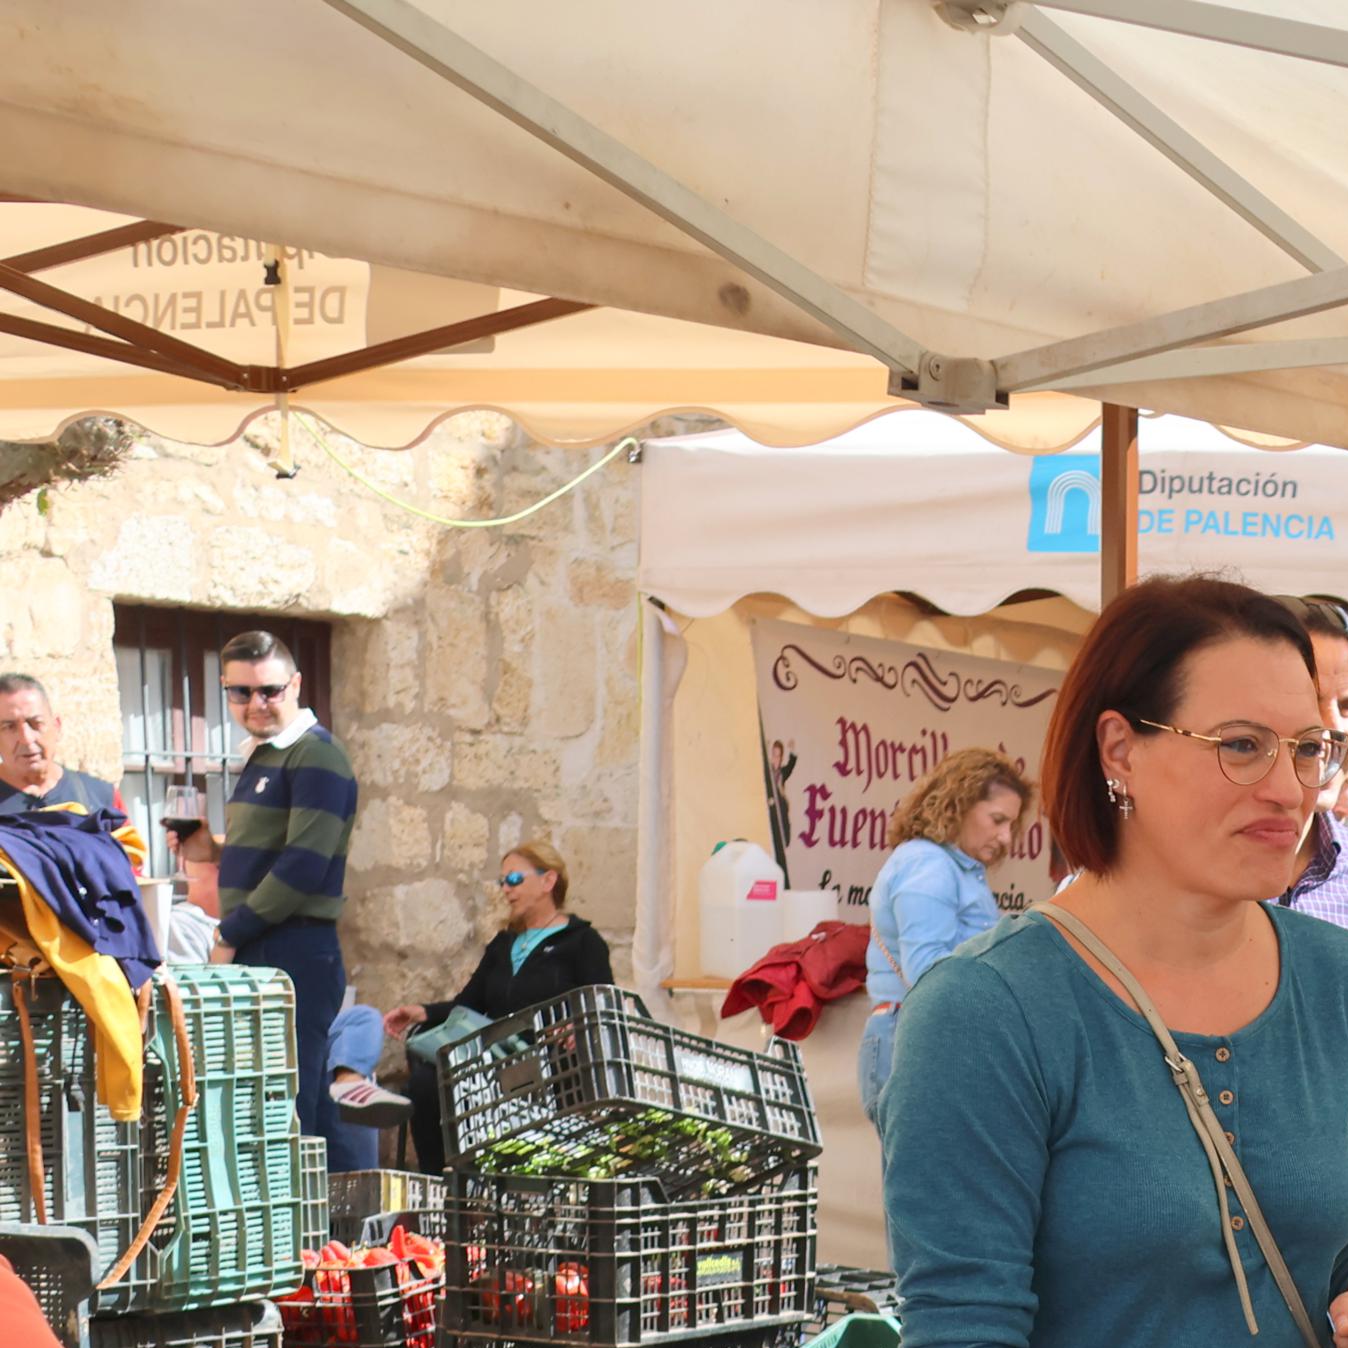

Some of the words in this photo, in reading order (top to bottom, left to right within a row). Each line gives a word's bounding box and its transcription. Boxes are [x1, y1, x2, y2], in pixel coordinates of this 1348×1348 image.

[1138, 469, 1298, 499] Diputación
[1138, 509, 1175, 534] DE
[1184, 509, 1335, 540] PALENCIA
